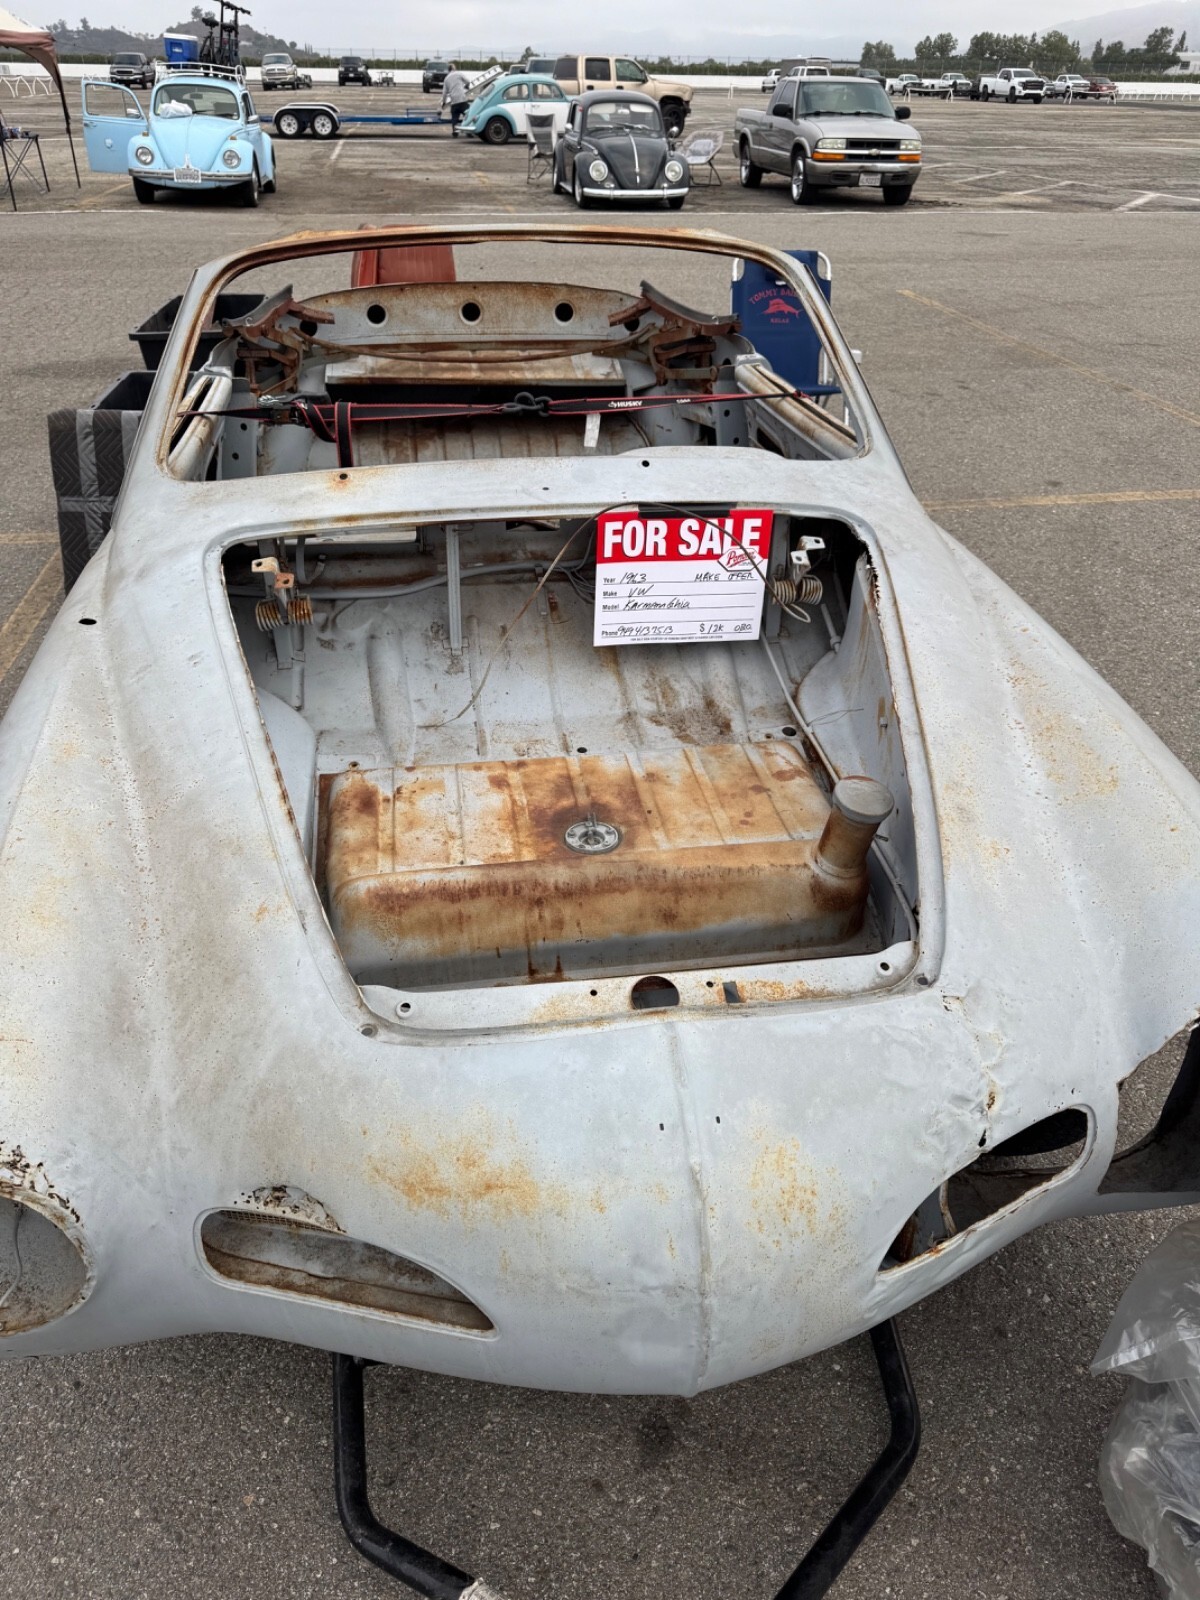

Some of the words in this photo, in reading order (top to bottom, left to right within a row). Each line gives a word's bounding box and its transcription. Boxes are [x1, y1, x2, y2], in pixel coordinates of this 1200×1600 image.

[603, 519, 667, 558] FOR
[677, 518, 762, 556] SALE
[619, 572, 647, 584] 1963
[694, 572, 721, 582] MAKE
[727, 572, 754, 581] OFFER
[628, 584, 655, 598] VW
